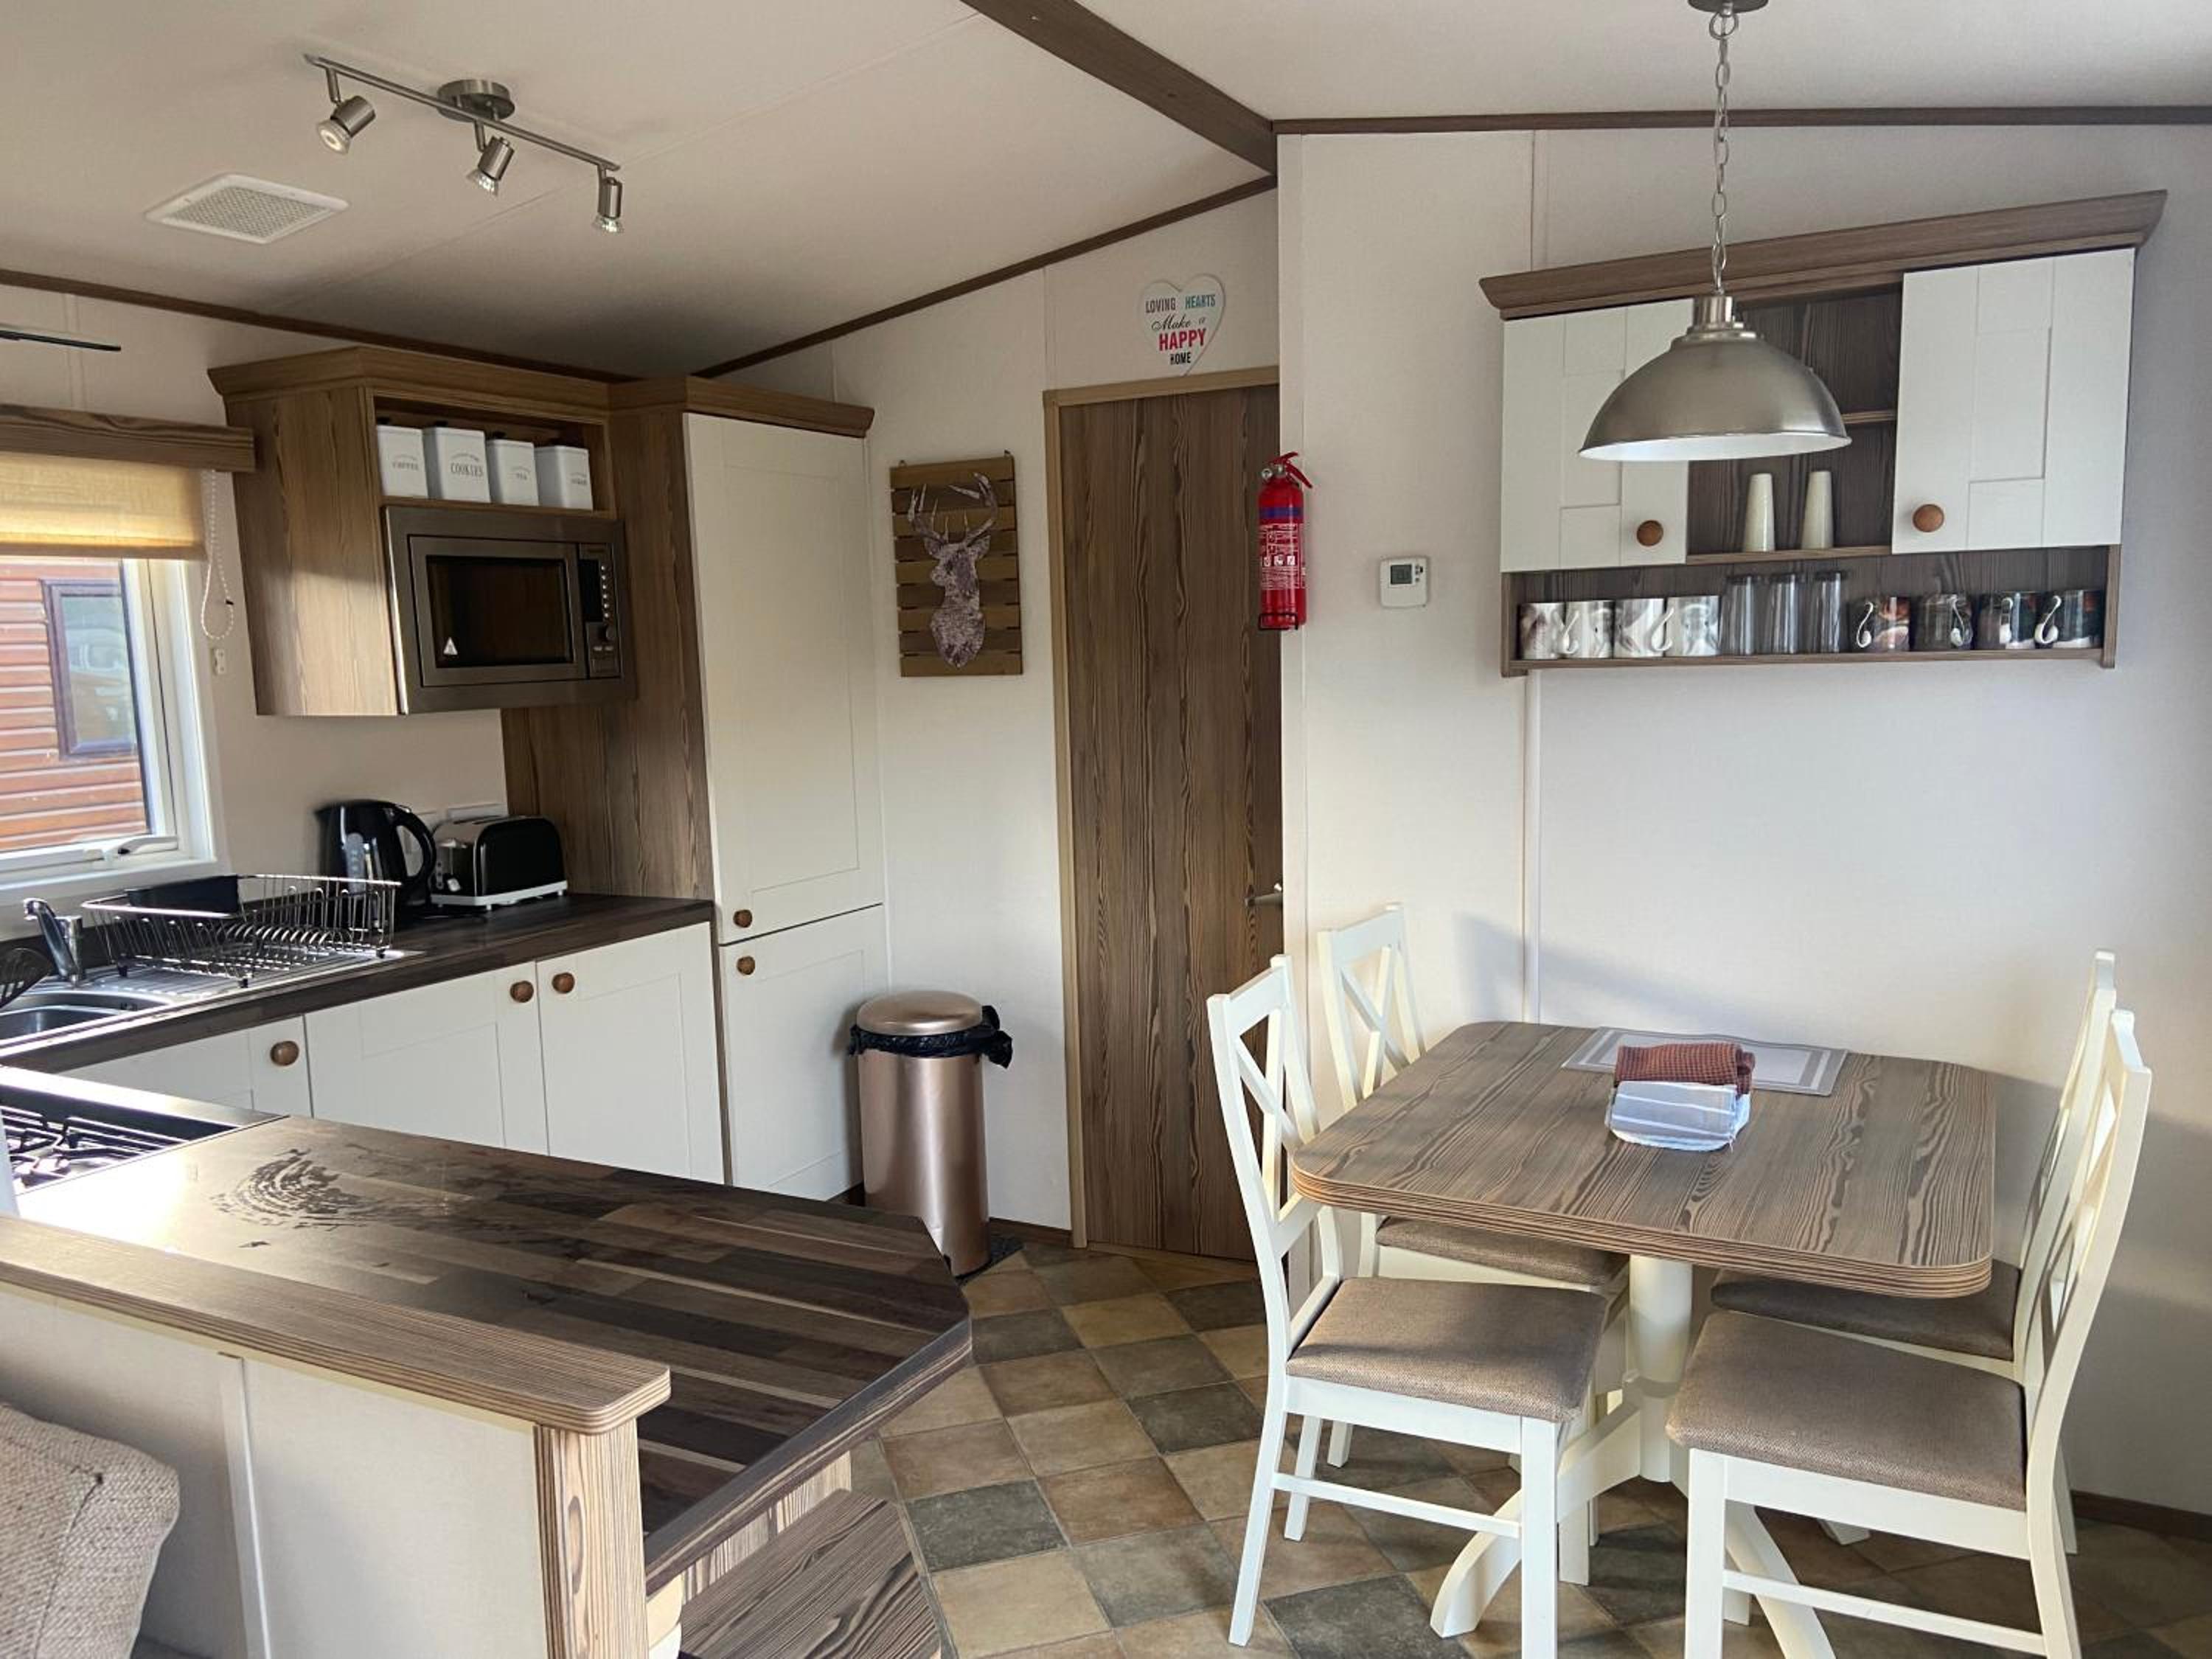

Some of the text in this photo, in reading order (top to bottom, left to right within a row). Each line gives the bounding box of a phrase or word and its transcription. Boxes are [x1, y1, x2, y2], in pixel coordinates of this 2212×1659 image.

[1145, 294, 1216, 313] LOVING HEARTS
[1158, 328, 1206, 351] HAPPY
